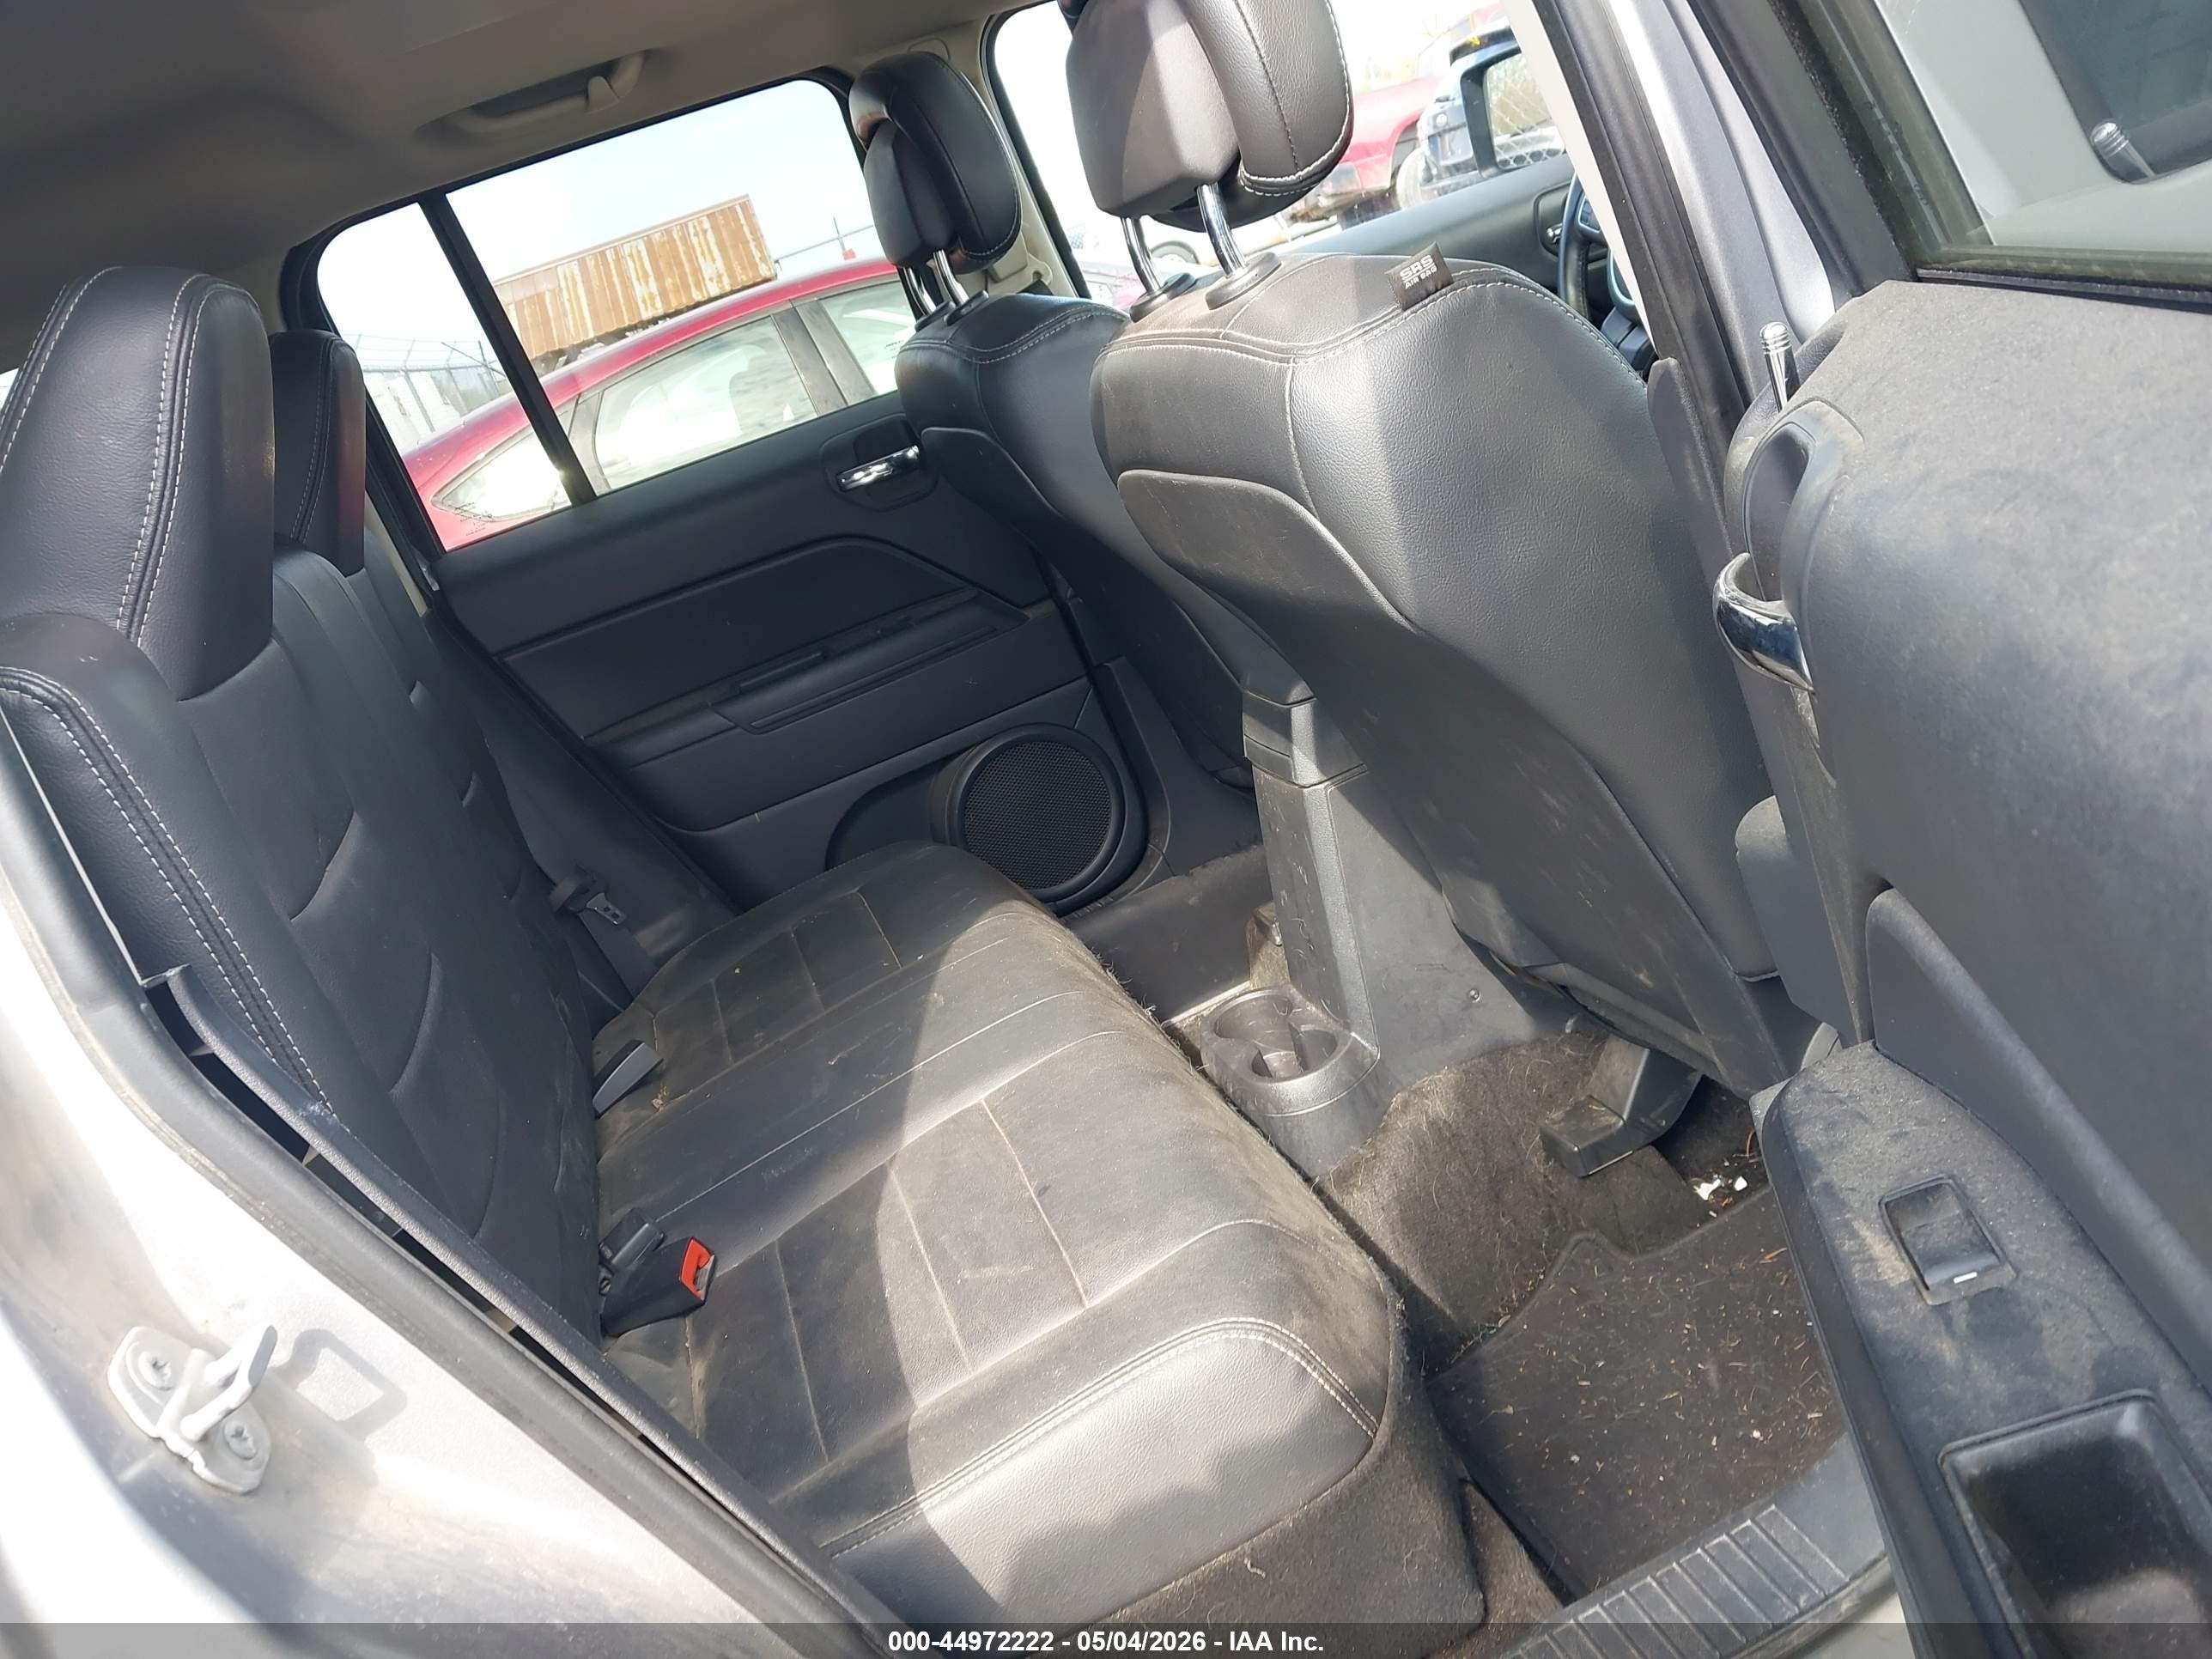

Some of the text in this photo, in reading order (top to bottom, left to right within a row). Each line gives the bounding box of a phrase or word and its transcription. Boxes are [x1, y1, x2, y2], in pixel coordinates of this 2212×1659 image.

[1400, 254, 1433, 277] SRS
[1405, 264, 1437, 289] AIR BAG
